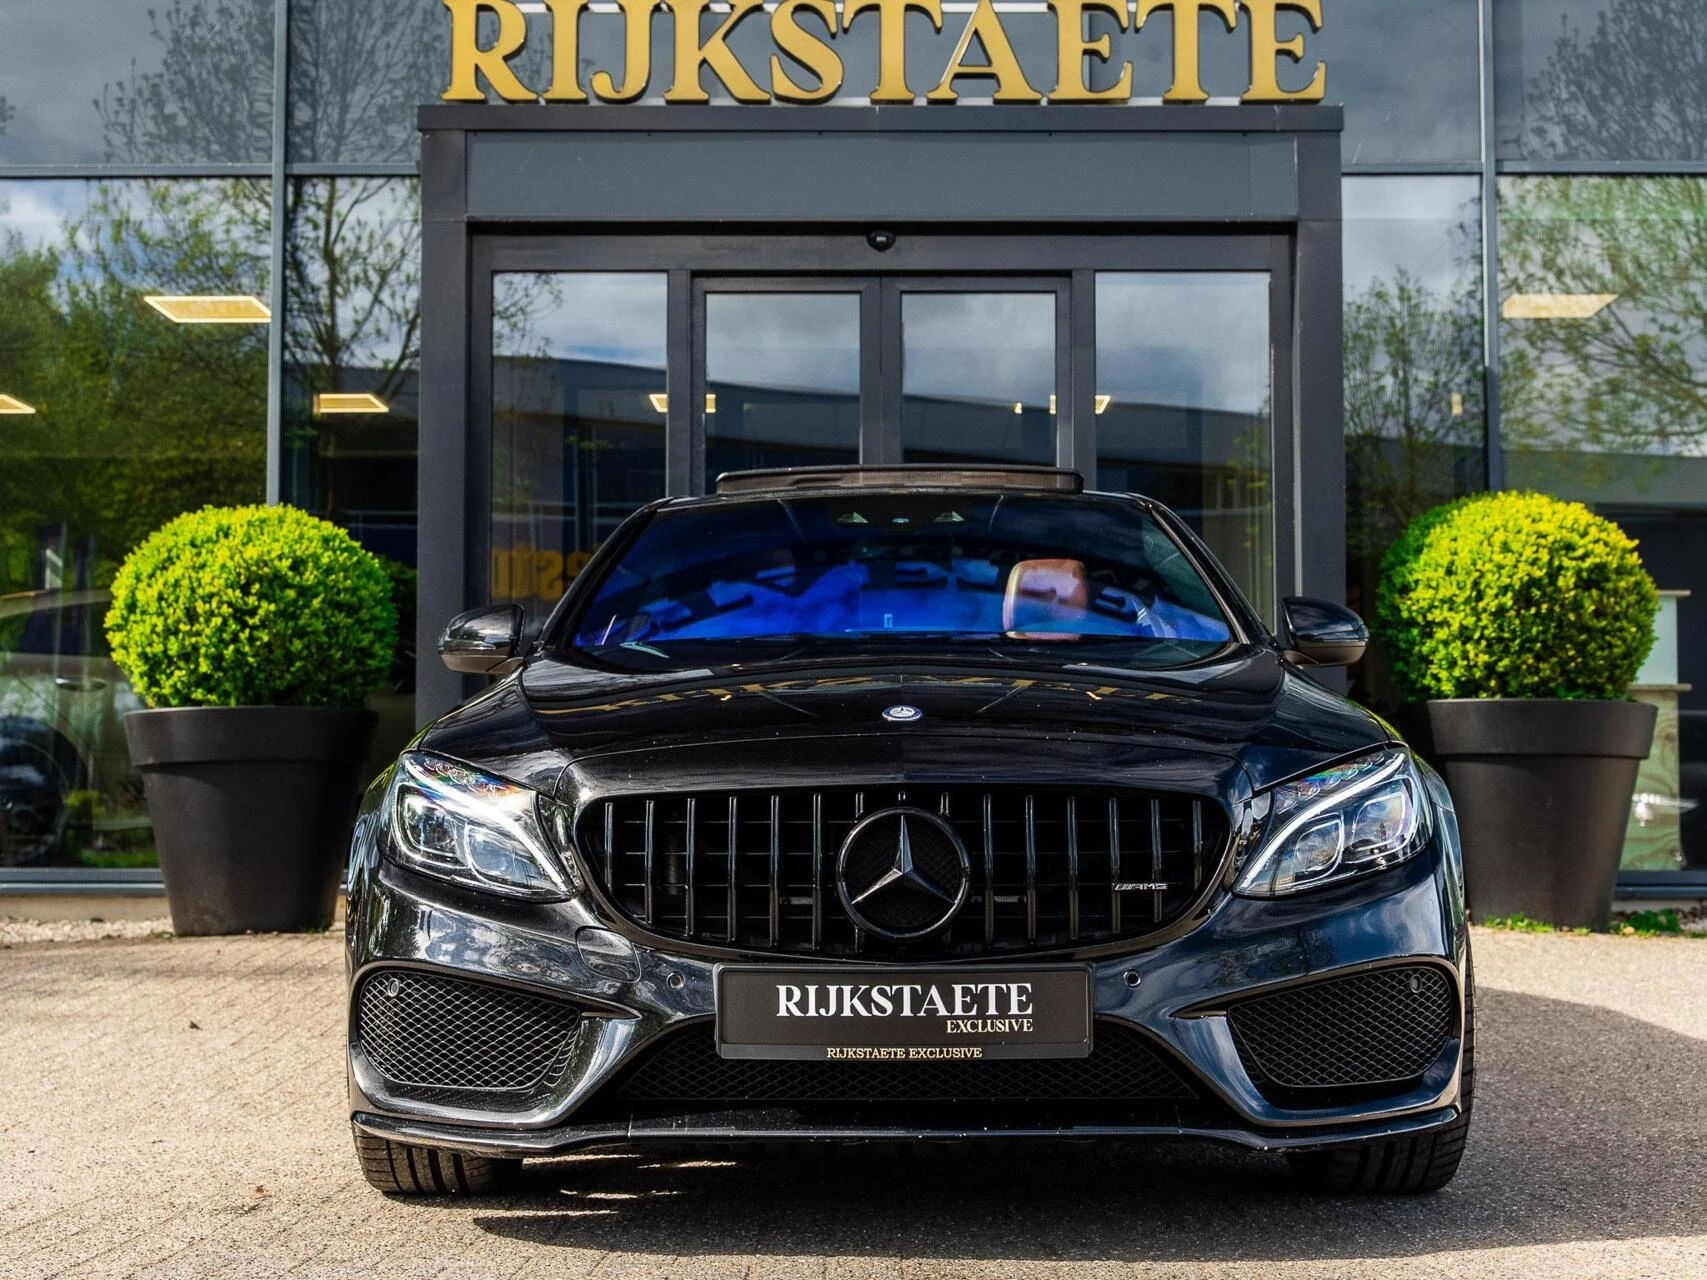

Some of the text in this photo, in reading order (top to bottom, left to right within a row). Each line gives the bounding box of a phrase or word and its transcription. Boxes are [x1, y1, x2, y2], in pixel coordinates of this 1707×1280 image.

[441, 0, 1327, 103] RIJKSTAETE
[776, 982, 1033, 1017] RIJKSTAETE
[946, 1018, 1033, 1033] EXCLUSIVE
[826, 1047, 982, 1059] RIJKSTAETE EXCLUSIVE
